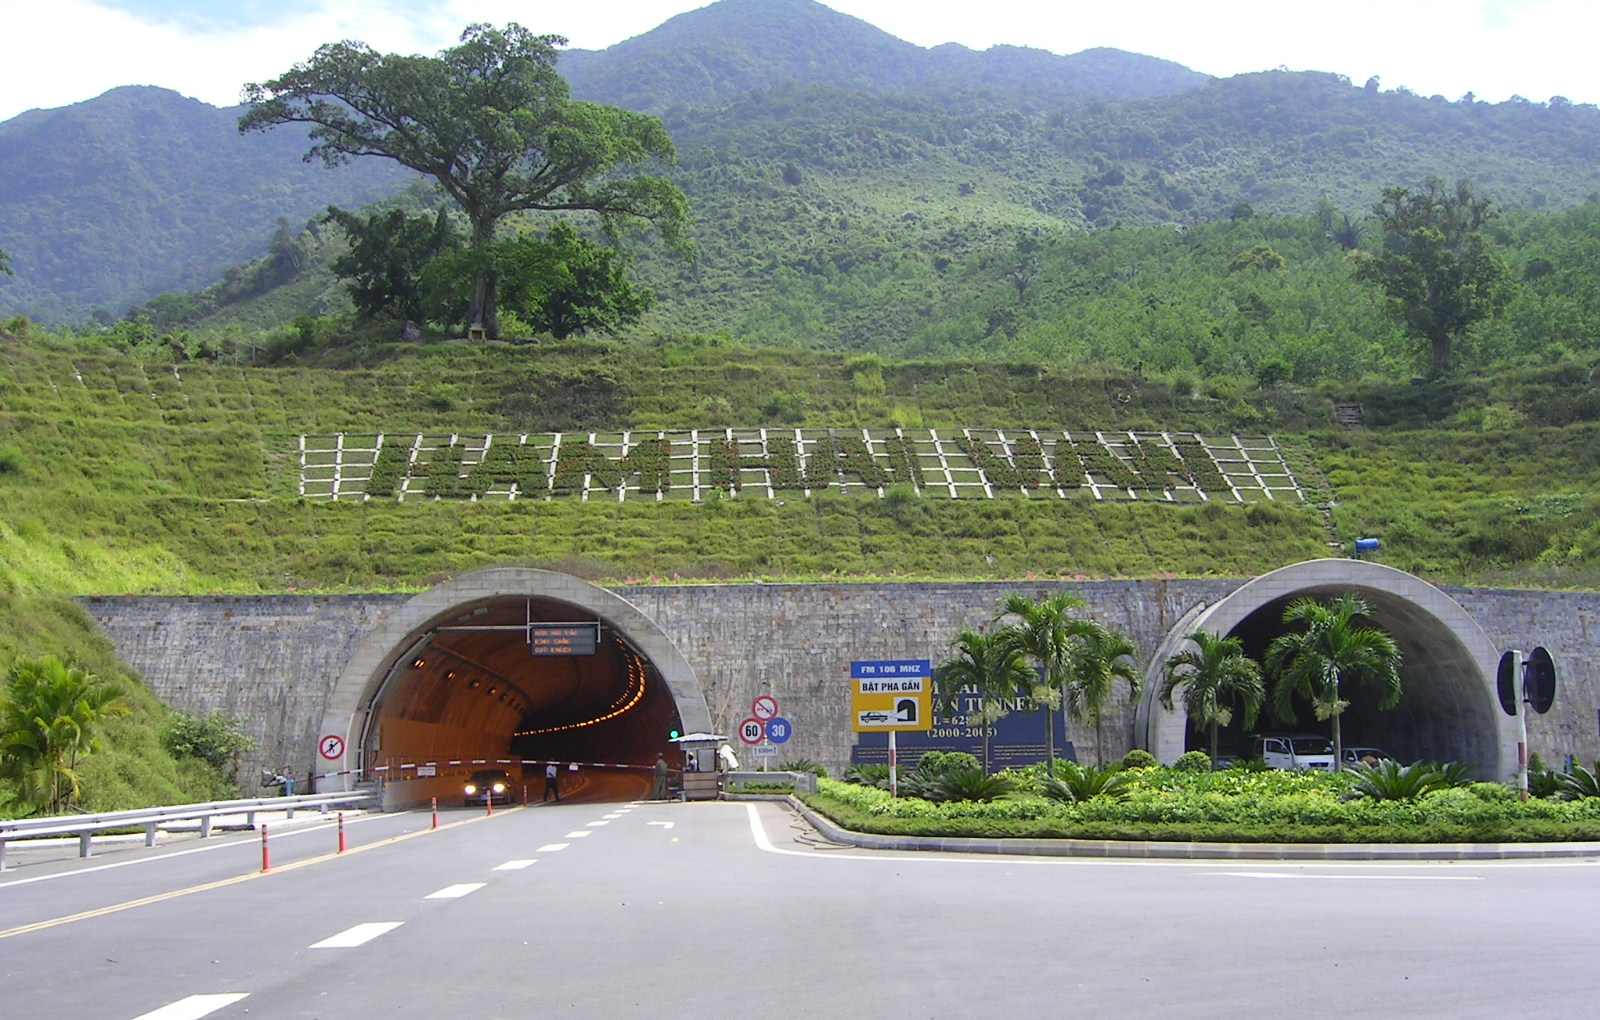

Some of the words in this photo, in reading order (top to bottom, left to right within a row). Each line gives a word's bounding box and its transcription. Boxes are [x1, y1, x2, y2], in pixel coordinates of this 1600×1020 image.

[861, 665, 876, 674] FM
[879, 665, 896, 673] 106
[900, 664, 921, 673] MHZ
[881, 682, 899, 691] PHA
[745, 725, 758, 736] 60
[772, 724, 785, 737] 30
